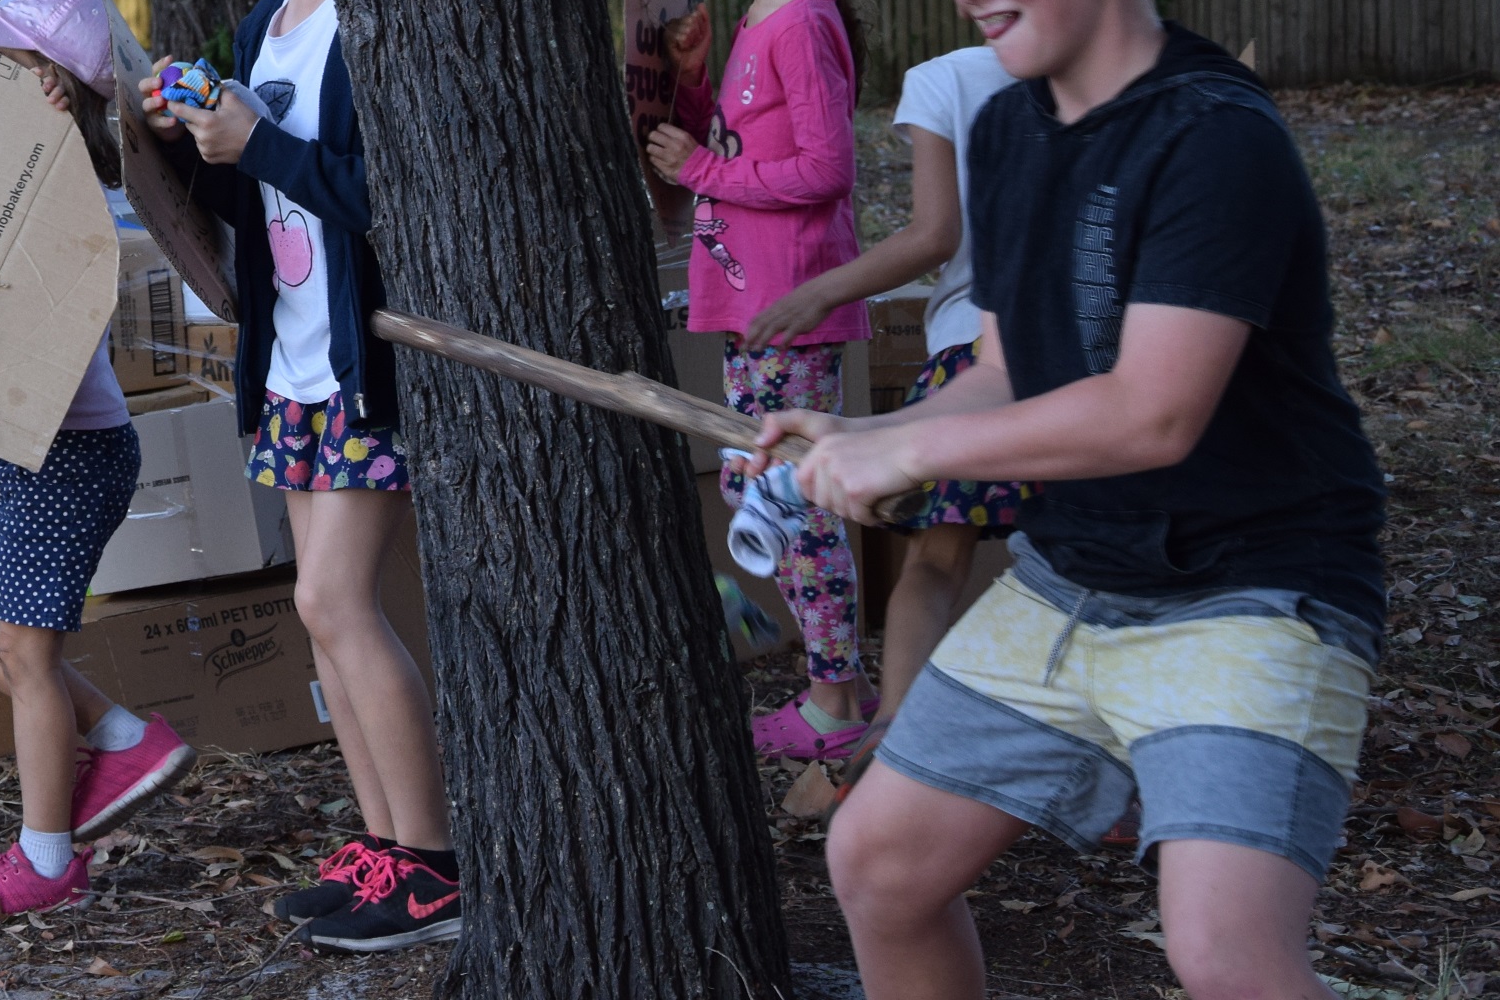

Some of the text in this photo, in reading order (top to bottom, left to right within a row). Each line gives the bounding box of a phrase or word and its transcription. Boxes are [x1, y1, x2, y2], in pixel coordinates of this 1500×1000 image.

[143, 624, 162, 640] 24
[165, 624, 173, 635] x
[220, 605, 249, 625] PET
[212, 636, 278, 677] Schweppes
